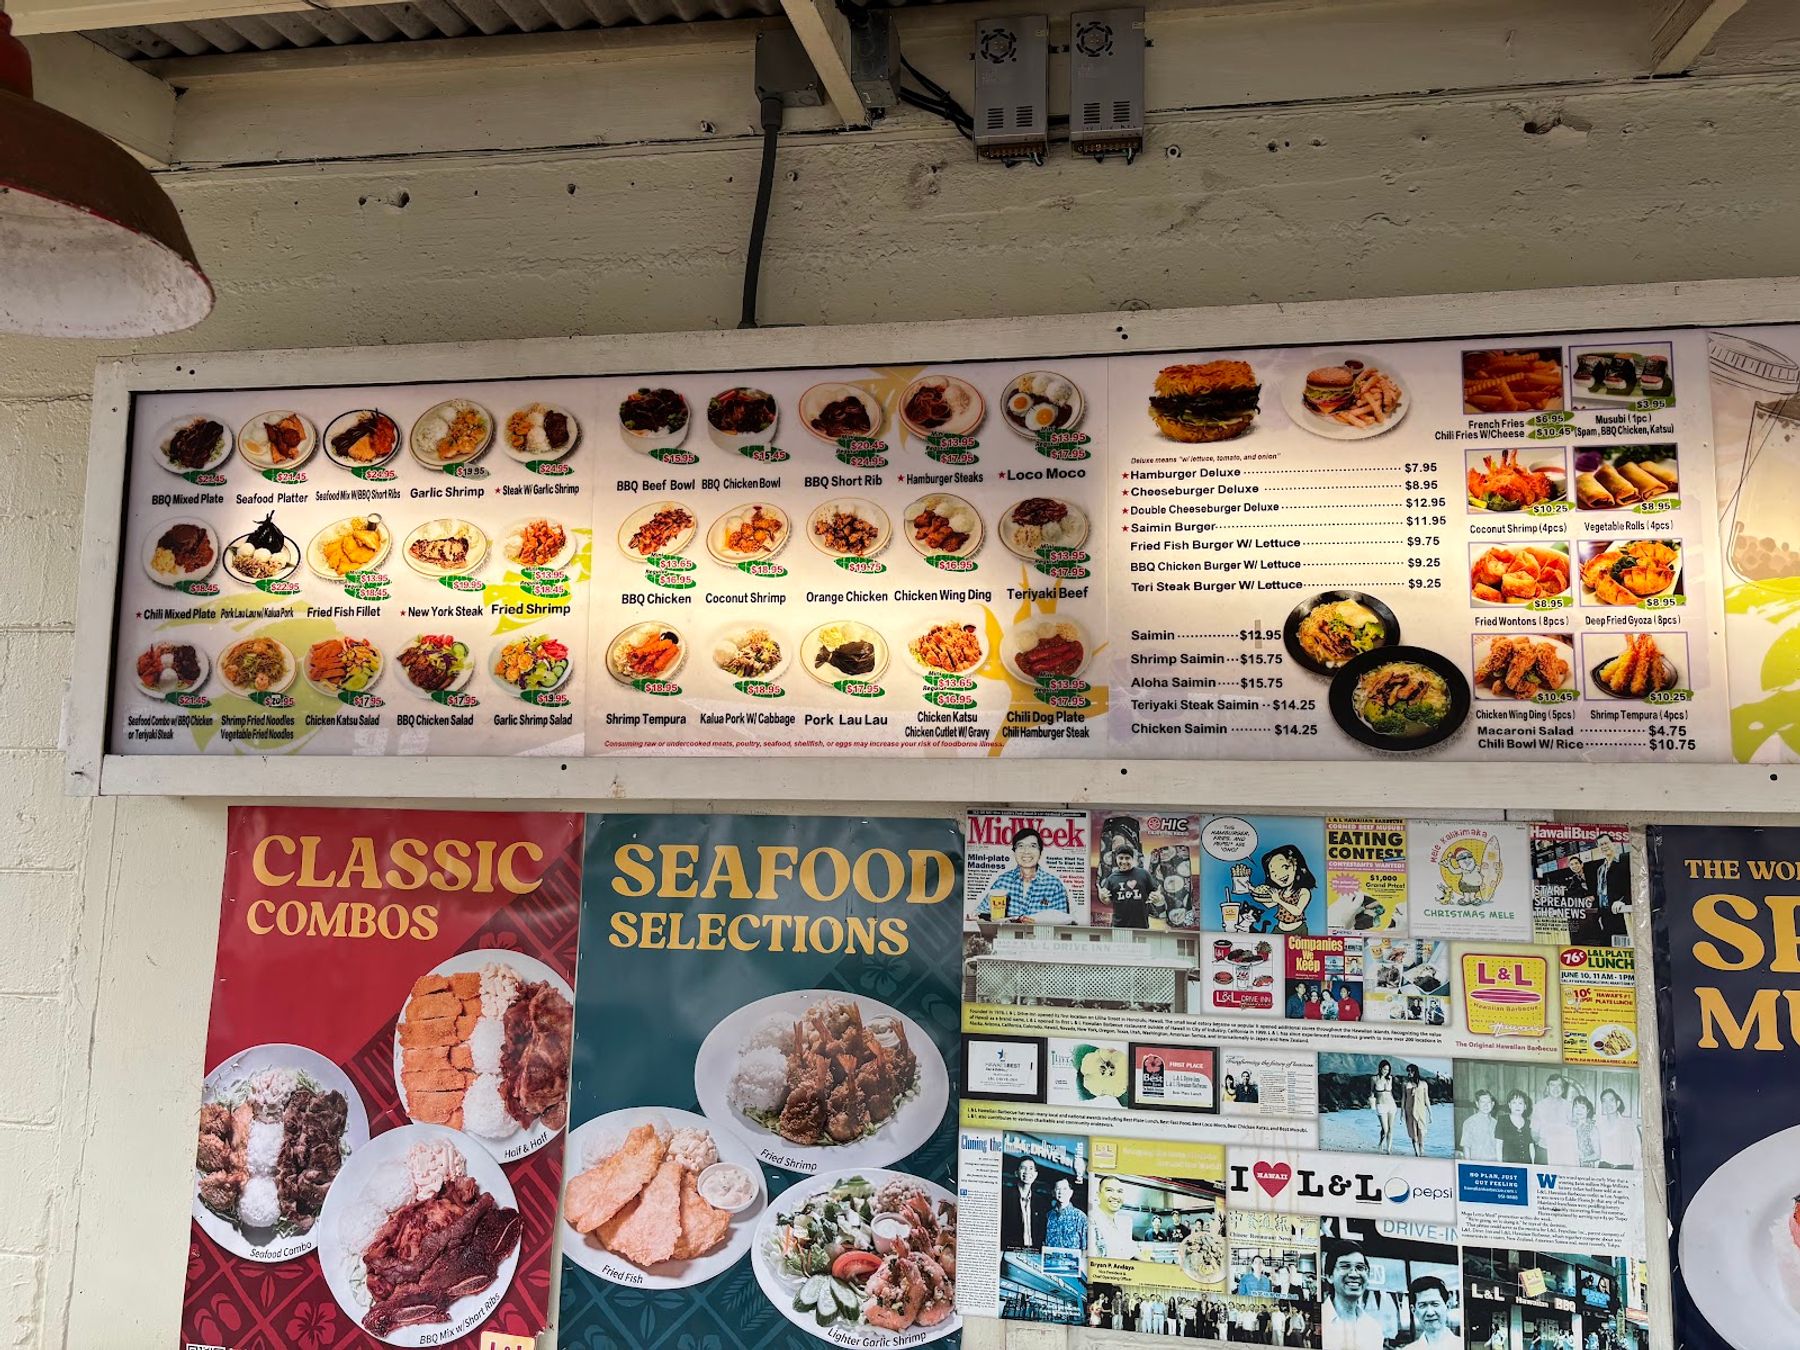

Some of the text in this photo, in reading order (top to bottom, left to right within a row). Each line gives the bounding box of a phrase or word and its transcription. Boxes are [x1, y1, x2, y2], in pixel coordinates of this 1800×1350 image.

[1469, 419, 1524, 428] French Fries
[1536, 414, 1564, 423] $6.95
[1007, 469, 1086, 481] Loco Moco
[1131, 463, 1437, 482] Hamburger Deluxe $7.95
[617, 479, 695, 493] BBQ Beef Bowl
[804, 475, 883, 489] BBQ Short Rib
[1131, 480, 1438, 497] Cheeseburger Deluxe $8.95
[410, 488, 484, 498] Garlic Shrimp
[1131, 497, 1446, 515] Double Cheeseburger Deluxe $12.95
[1131, 516, 1446, 533] Saimin Burger $11.95
[1130, 536, 1440, 551] Fried Fish Burger W/ Lettuce $9.75
[1131, 557, 1440, 572] BBQ Chicken Burger W/ Lettuce $9.25
[1131, 578, 1441, 592] Teri Steak Burger W/ Lettuce $9.25
[706, 592, 786, 604] Coconut Shrimp
[894, 589, 992, 602] Chicken Wing Ding
[144, 608, 215, 619] Chili Mixed Plate
[307, 605, 380, 618] Fried Fish Fillet
[409, 606, 483, 616] New York Steak
[492, 604, 571, 615] Fried Shrimp
[1131, 630, 1281, 641] Saimin $12.95
[1131, 654, 1282, 666] Shrimp Saimin $15.75
[1131, 677, 1283, 689] Aloha Saimin $15.75
[1131, 699, 1315, 712] Teriyaki Steak Saimin $14.25
[1131, 724, 1317, 735] Chicken Saimin $14.25
[1478, 726, 1686, 737] Macaroni Salad $4.75
[1478, 739, 1696, 750] Chili Bowl W/ Rice $10.75
[1162, 819, 1188, 831] HIC
[1328, 832, 1402, 846] EATING
[968, 854, 1010, 862] Mini-plate
[1328, 847, 1403, 860] CONTEST
[252, 835, 543, 894] CLASSIC
[968, 862, 1005, 870] Madness
[1684, 860, 1800, 881] THE WO
[611, 843, 955, 904] SEAFOOD
[1535, 885, 1567, 896] START
[1535, 897, 1593, 908] SPREADING
[247, 900, 439, 940] COMBOS
[1424, 909, 1514, 919] CHRISTMAS MELE
[1535, 908, 1586, 919] THE NEWS
[608, 912, 909, 955] SELECTIONS
[1288, 936, 1343, 951] Companies
[1303, 950, 1314, 960] We
[1588, 950, 1604, 958] L&L
[1296, 959, 1320, 972] Keep
[1588, 958, 1634, 970] LUNCH
[1469, 1041, 1494, 1049] Original
[1143, 1074, 1163, 1082] Best
[504, 1132, 548, 1159] Half & Half
[761, 1148, 818, 1172] Fried Shrimp
[1230, 1166, 1248, 1192] I
[1257, 1172, 1288, 1180] HAWAII
[1412, 1188, 1453, 1200] pepsi
[249, 1240, 312, 1259] Seafood Combo
[602, 1264, 644, 1284] Fried Fish
[419, 1333, 439, 1345] BBQ
[439, 1328, 455, 1342] Mix
[484, 1292, 501, 1312] Ribs
[827, 1327, 927, 1349] Lighter Garlic Shrimp
